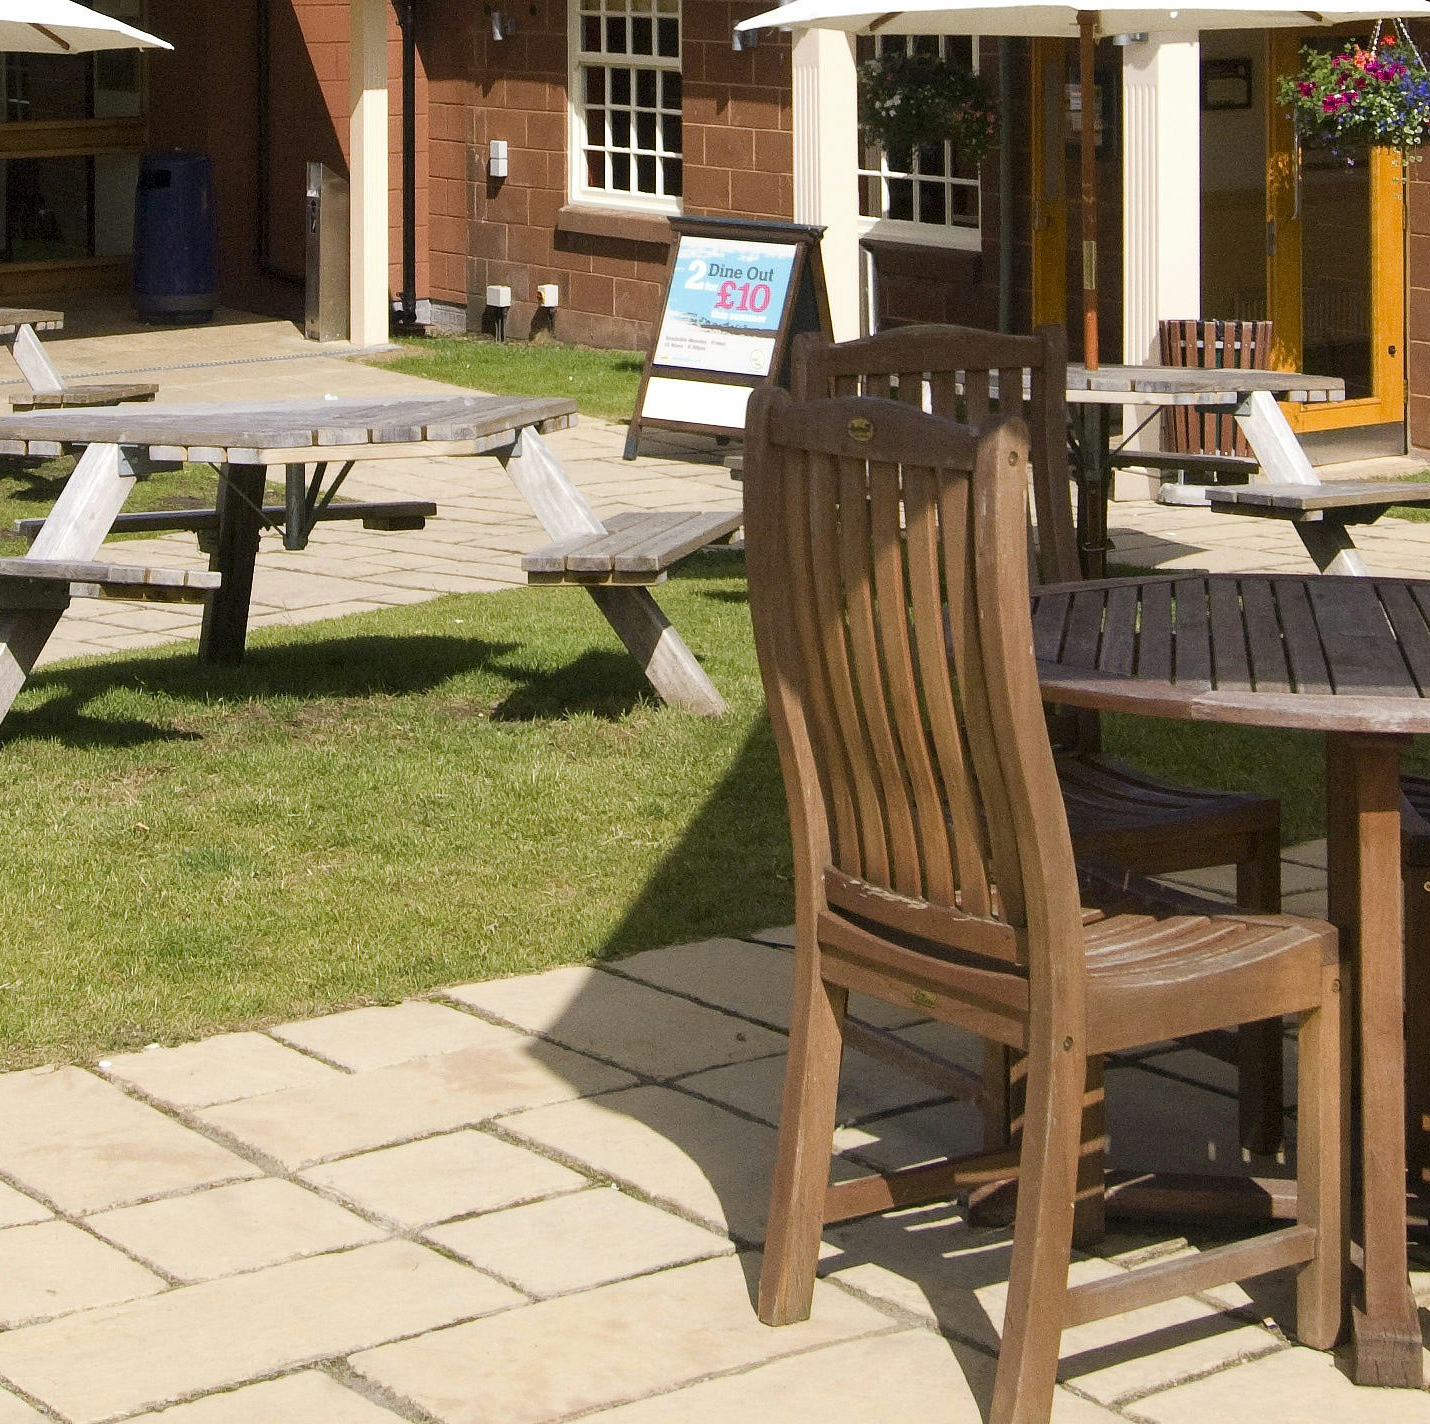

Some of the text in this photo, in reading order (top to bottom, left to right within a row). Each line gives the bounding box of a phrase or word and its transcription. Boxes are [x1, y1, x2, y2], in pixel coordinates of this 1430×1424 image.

[685, 259, 775, 289] 2 Dine Out
[714, 280, 771, 313] £10
